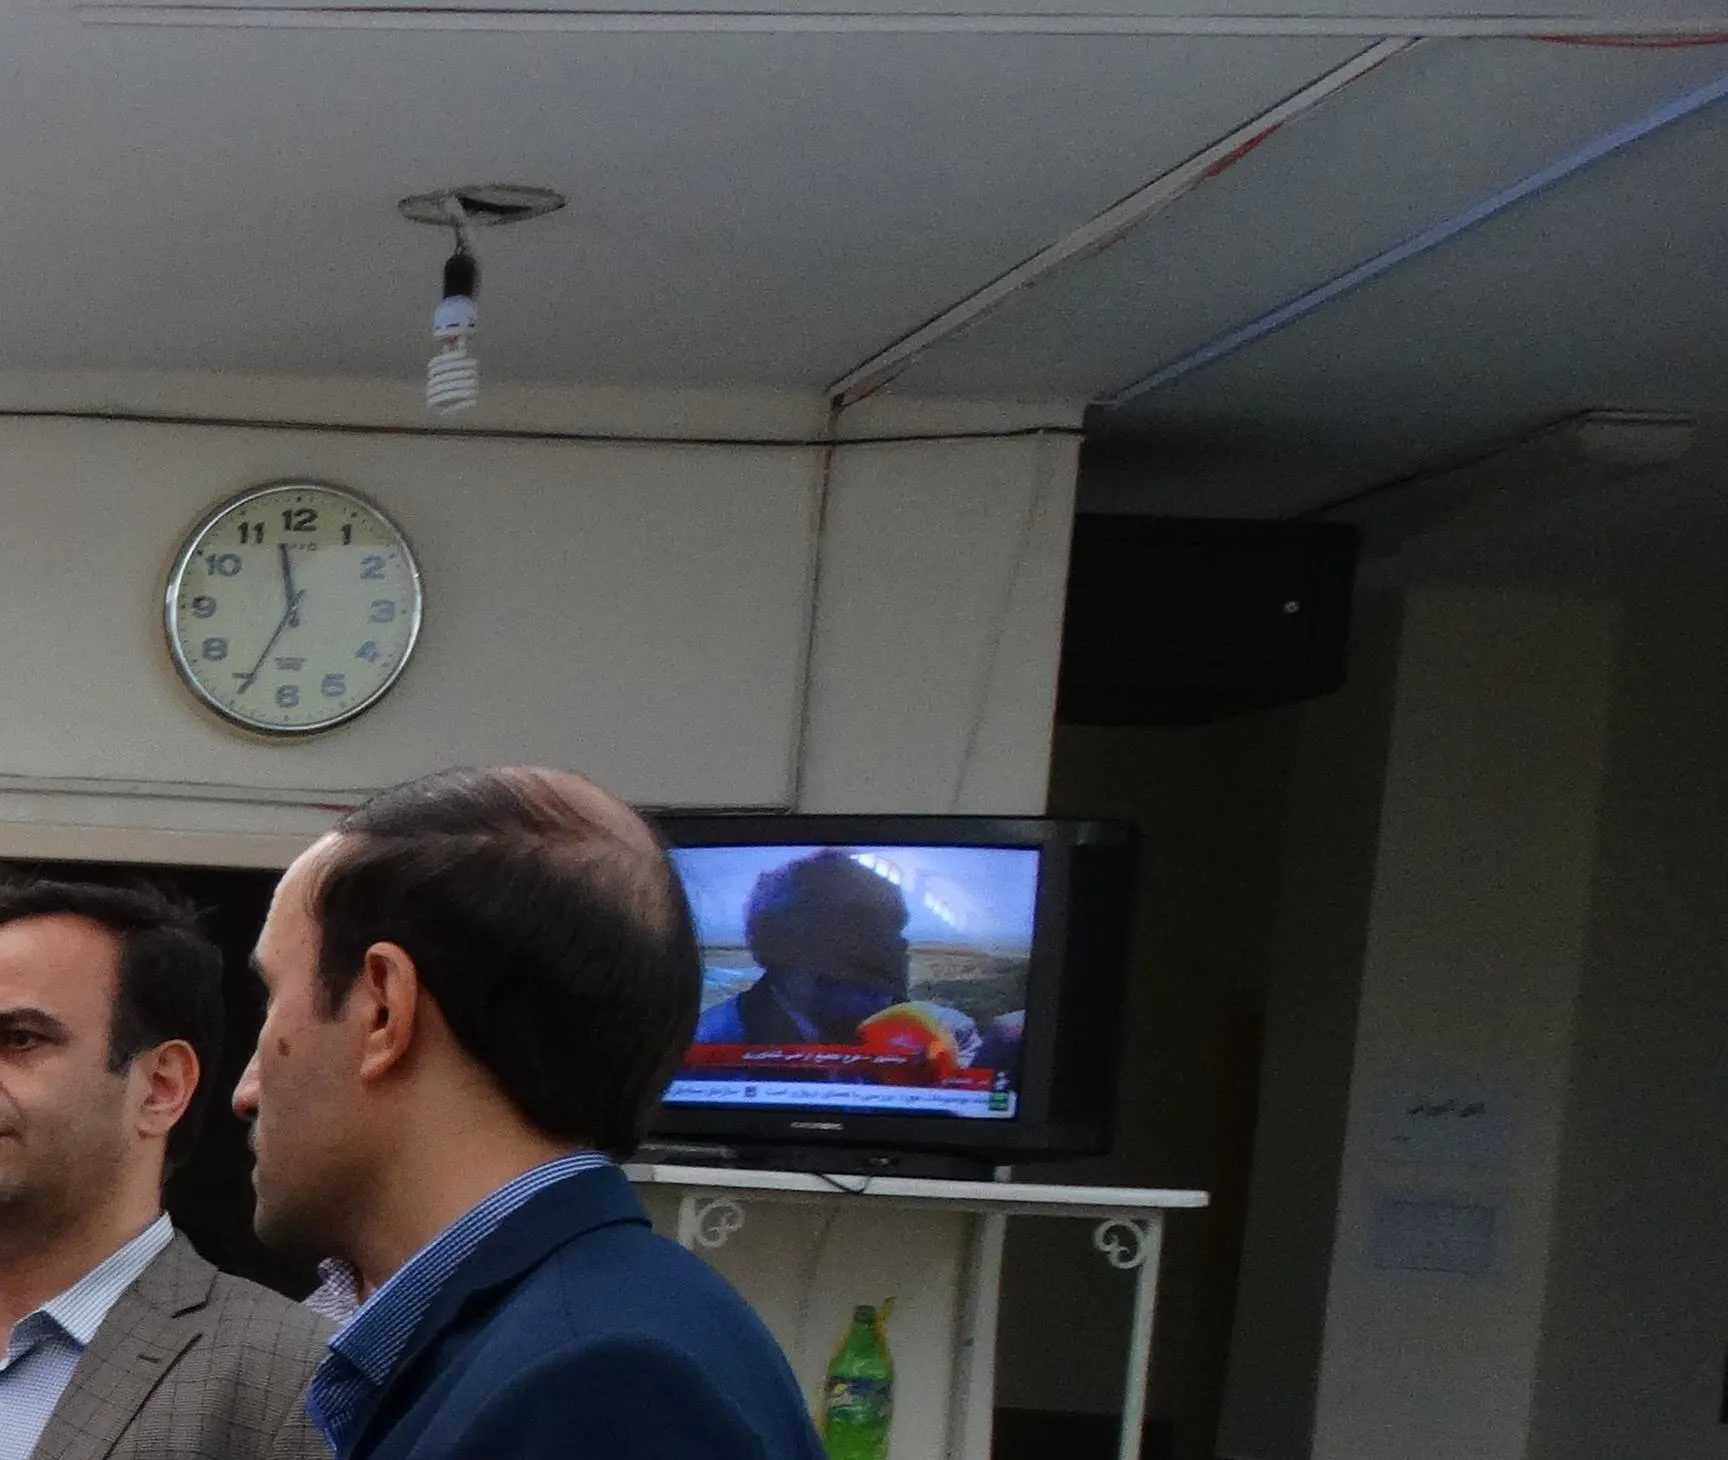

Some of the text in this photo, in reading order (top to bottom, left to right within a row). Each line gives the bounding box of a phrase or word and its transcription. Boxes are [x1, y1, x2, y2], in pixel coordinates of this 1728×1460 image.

[282, 508, 318, 532] 12
[238, 521, 266, 544] 11
[340, 523, 353, 545] 1
[206, 552, 242, 577] 10
[359, 554, 386, 580] 2
[191, 595, 216, 619] 9
[370, 599, 396, 623] 3
[201, 637, 228, 661] 8
[354, 640, 379, 662] 4
[274, 684, 300, 708] 6
[320, 673, 346, 697] 5
